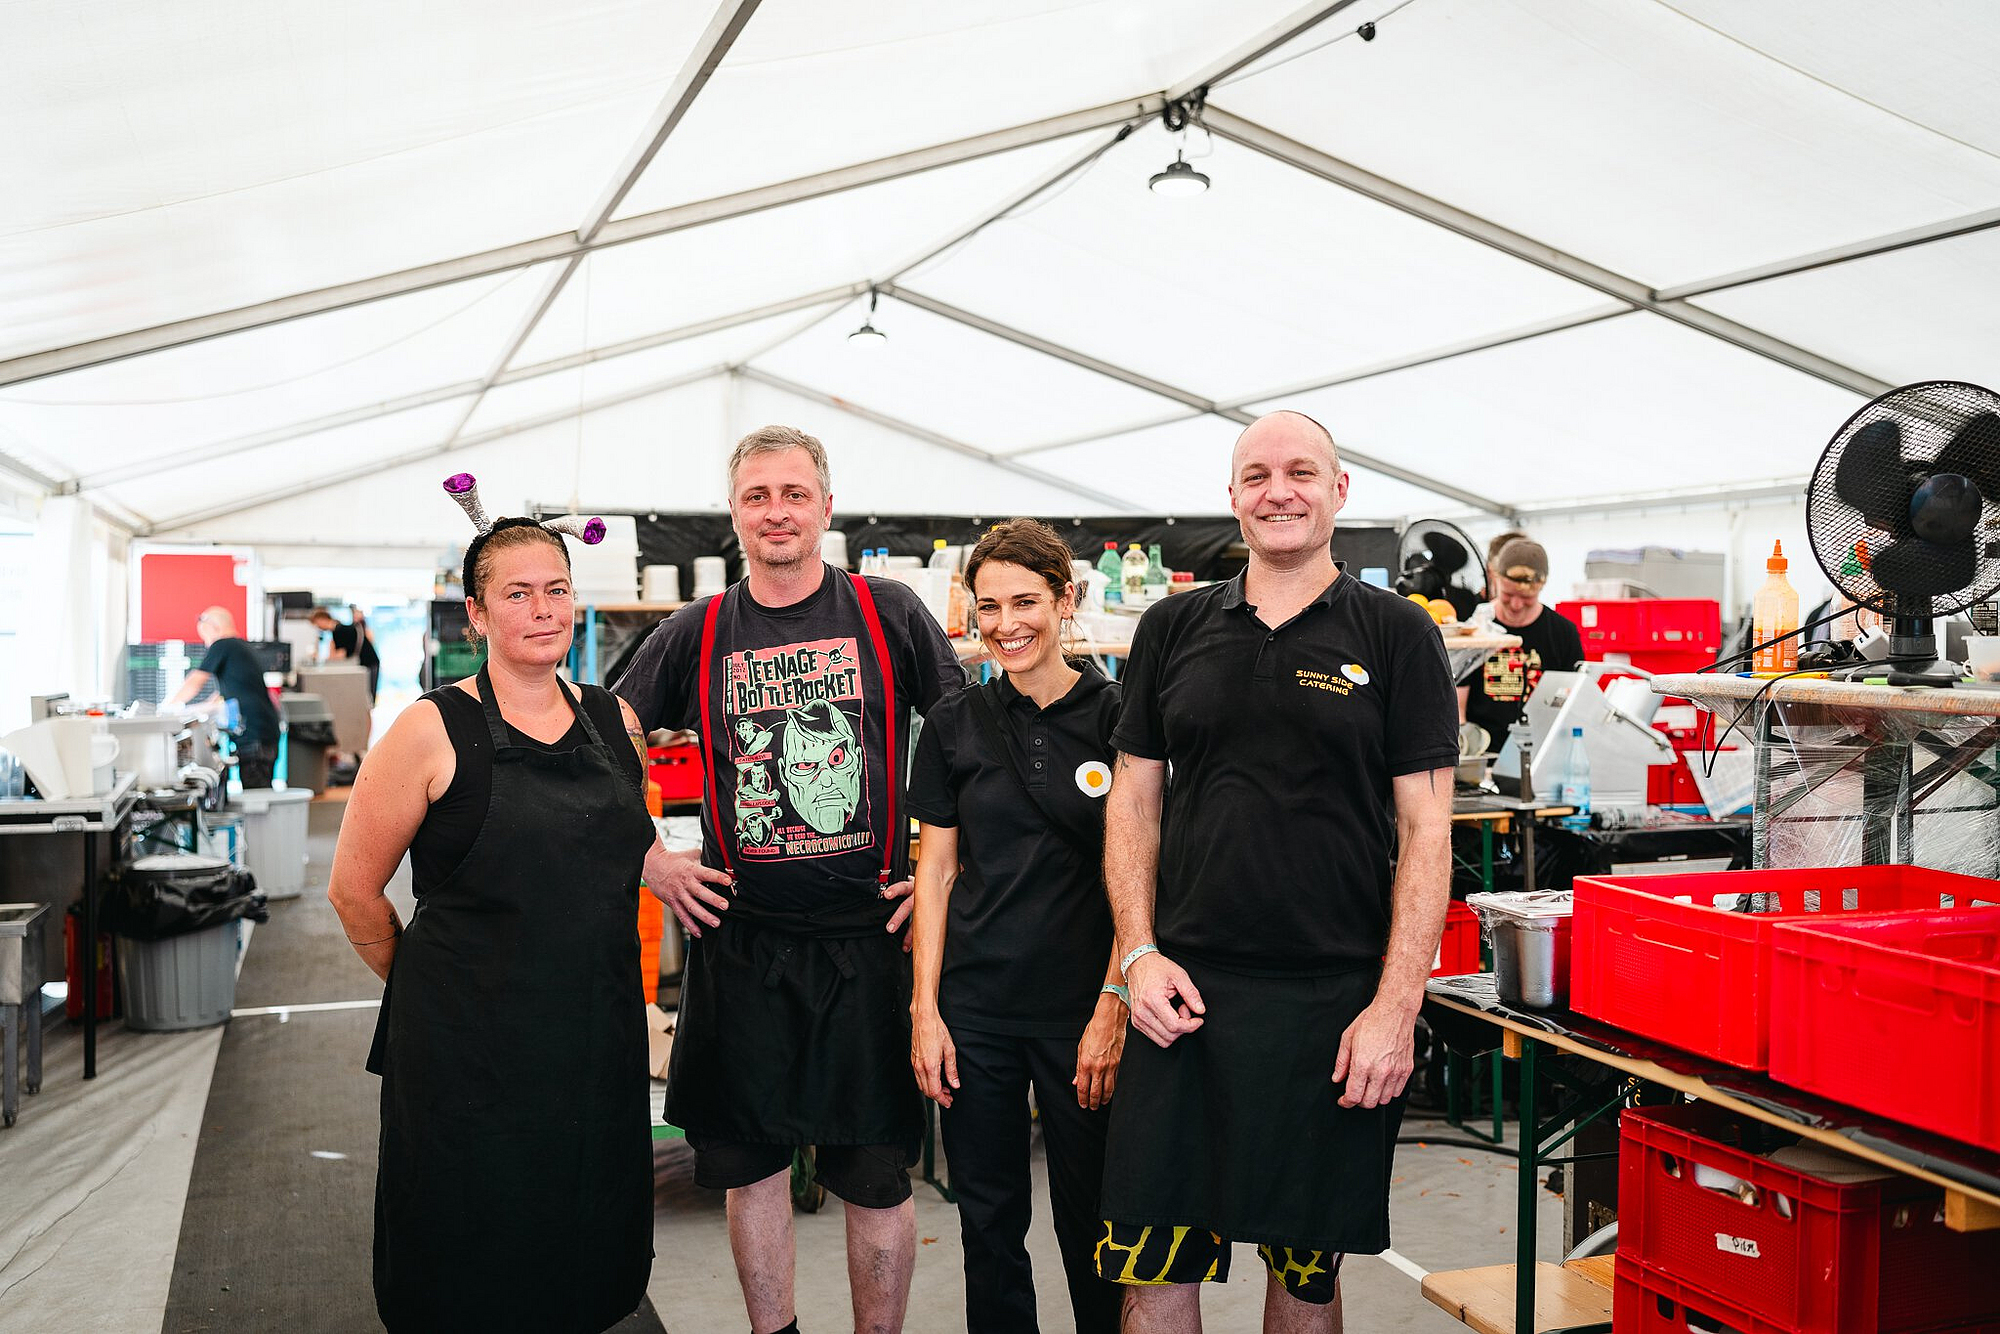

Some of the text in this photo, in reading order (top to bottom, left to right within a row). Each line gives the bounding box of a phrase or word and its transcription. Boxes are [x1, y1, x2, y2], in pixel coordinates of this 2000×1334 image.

[744, 648, 818, 688] TEENAGE
[1295, 669, 1354, 690] SUNNY SIDE
[1299, 679, 1349, 696] CATERING
